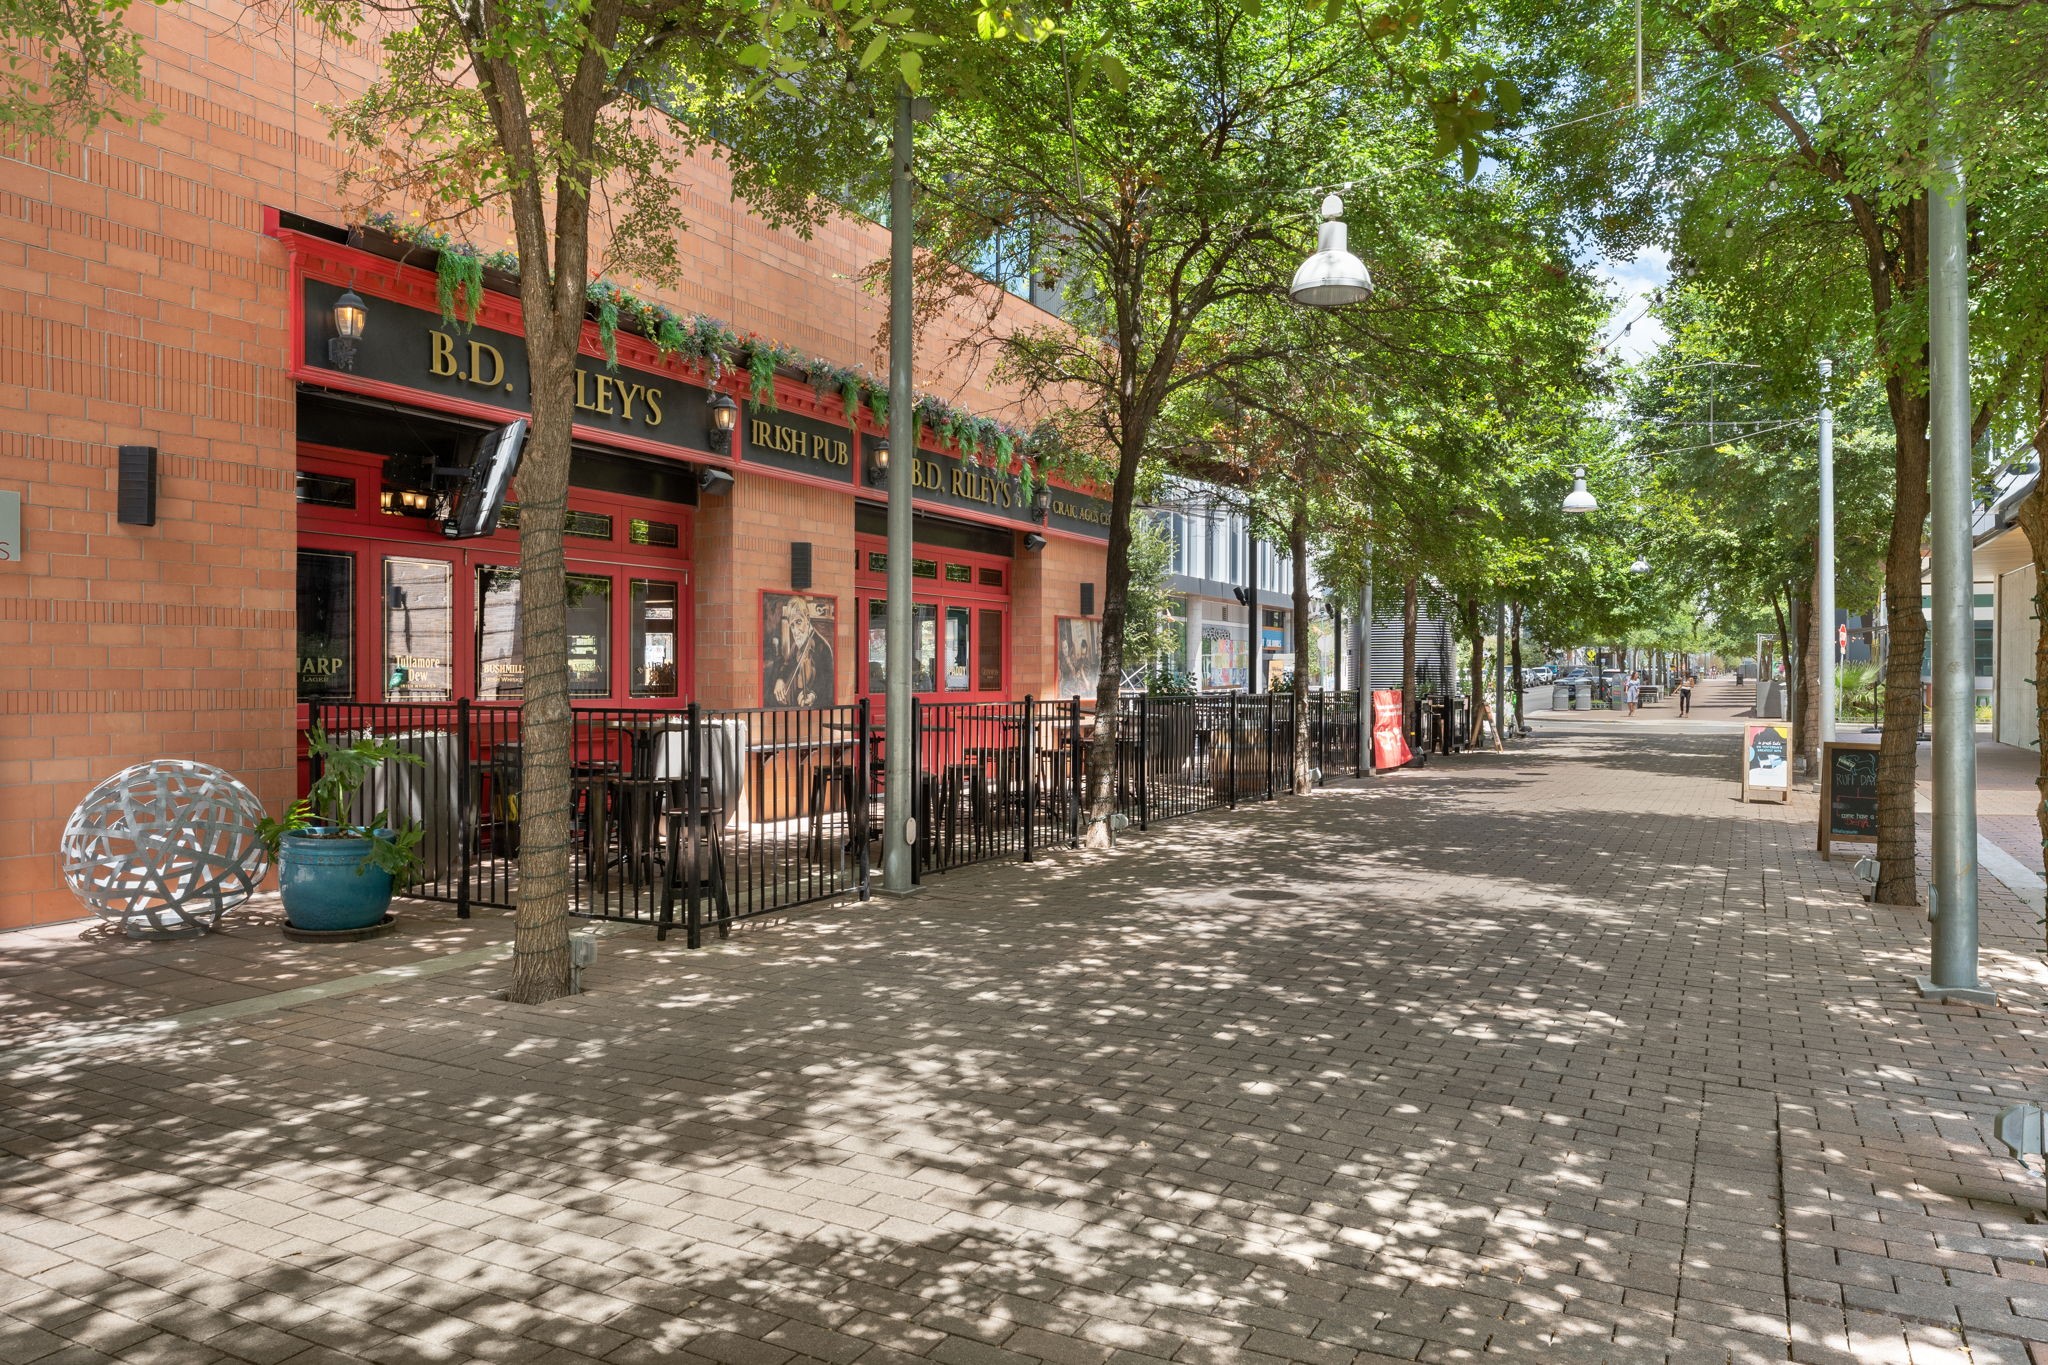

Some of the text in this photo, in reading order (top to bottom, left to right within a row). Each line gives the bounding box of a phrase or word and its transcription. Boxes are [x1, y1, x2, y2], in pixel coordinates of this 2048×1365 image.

[429, 330, 662, 426] B.D. LEY'S
[751, 419, 849, 465] IRISH PUB
[912, 458, 1011, 509] B.D. RILEY'S
[1053, 500, 1077, 519] CRAIC
[395, 655, 440, 668] Tullamore
[483, 664, 525, 674] BUSHMILL
[408, 668, 428, 682] Dew
